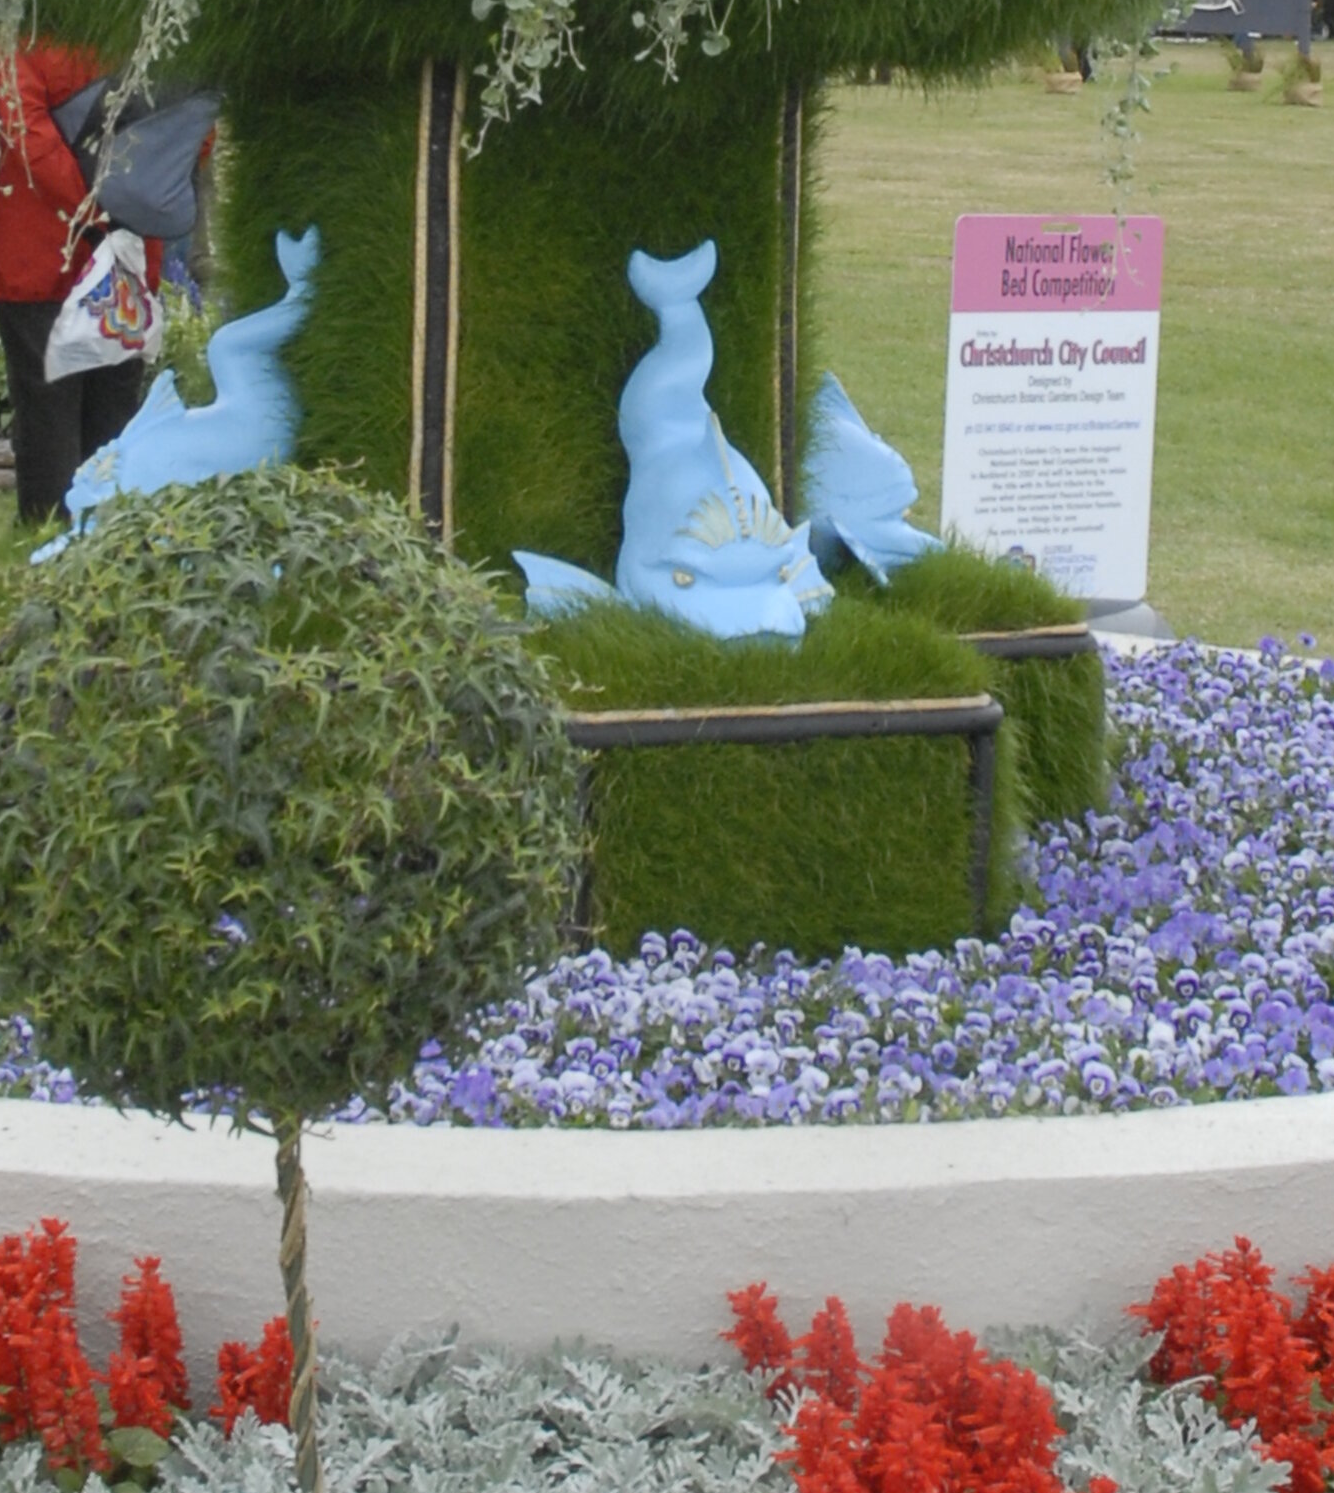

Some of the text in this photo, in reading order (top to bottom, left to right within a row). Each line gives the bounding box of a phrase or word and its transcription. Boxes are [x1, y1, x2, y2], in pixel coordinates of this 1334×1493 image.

[1005, 234, 1115, 264] National Flower
[1001, 267, 1115, 303] Bed Competition
[960, 337, 1147, 371] Christchurch City Council
[972, 389, 1126, 405] Christchurch Botanic Gardens Design Team
[1028, 375, 1072, 389] Designed by
